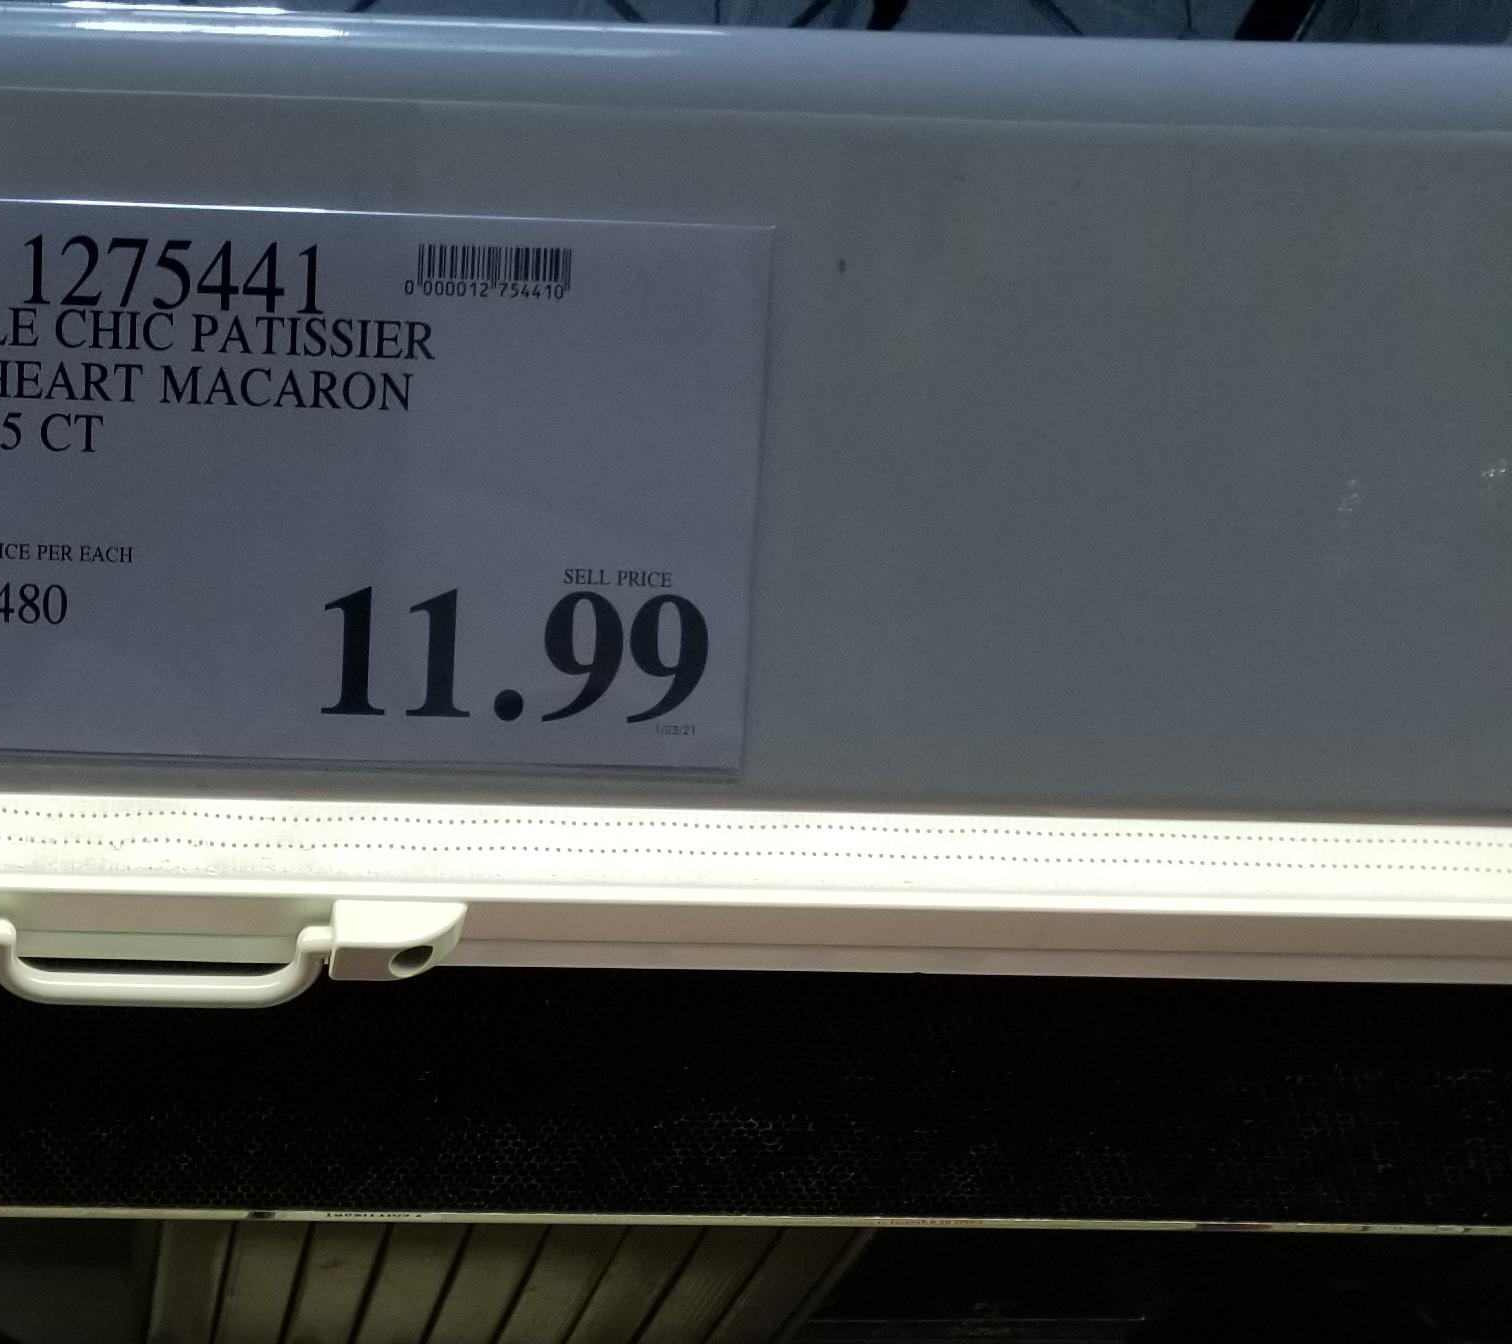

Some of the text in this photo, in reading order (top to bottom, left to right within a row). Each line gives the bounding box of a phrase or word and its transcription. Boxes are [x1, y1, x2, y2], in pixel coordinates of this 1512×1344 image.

[23, 235, 324, 314] 1275441
[424, 280, 489, 298] 000012
[499, 282, 564, 300] 754410
[55, 308, 175, 353] CHIC
[191, 312, 436, 361] PATISSIER
[160, 364, 414, 411] MACARON
[39, 414, 104, 454] CT
[37, 544, 73, 562] PER
[78, 545, 133, 564] EACH
[562, 567, 672, 589] SELL PRICE
[320, 585, 709, 724] 11.99
